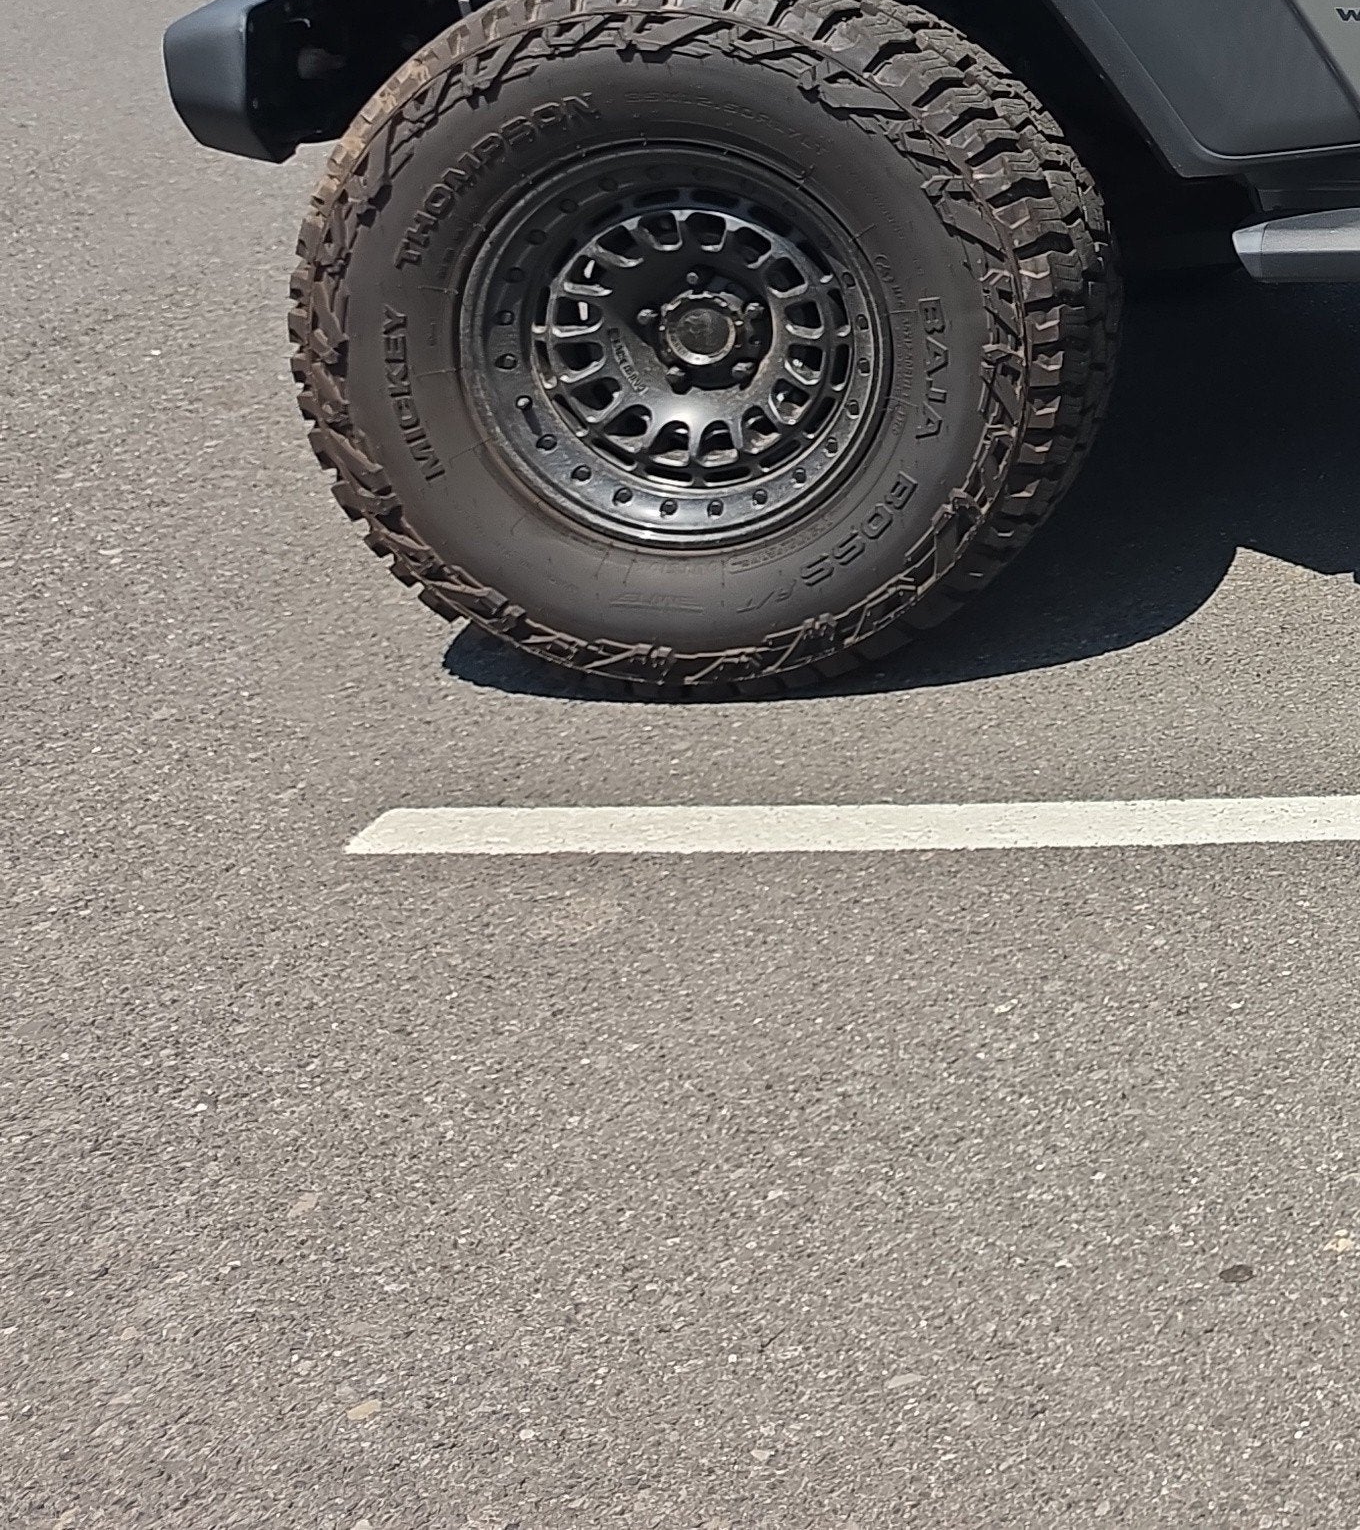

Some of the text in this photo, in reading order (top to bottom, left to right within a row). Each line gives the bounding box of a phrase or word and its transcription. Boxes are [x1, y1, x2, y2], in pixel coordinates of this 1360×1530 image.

[383, 91, 602, 482] MICKEY THOMPSON
[914, 295, 951, 441] BAJA
[800, 470, 919, 587] BOSS
